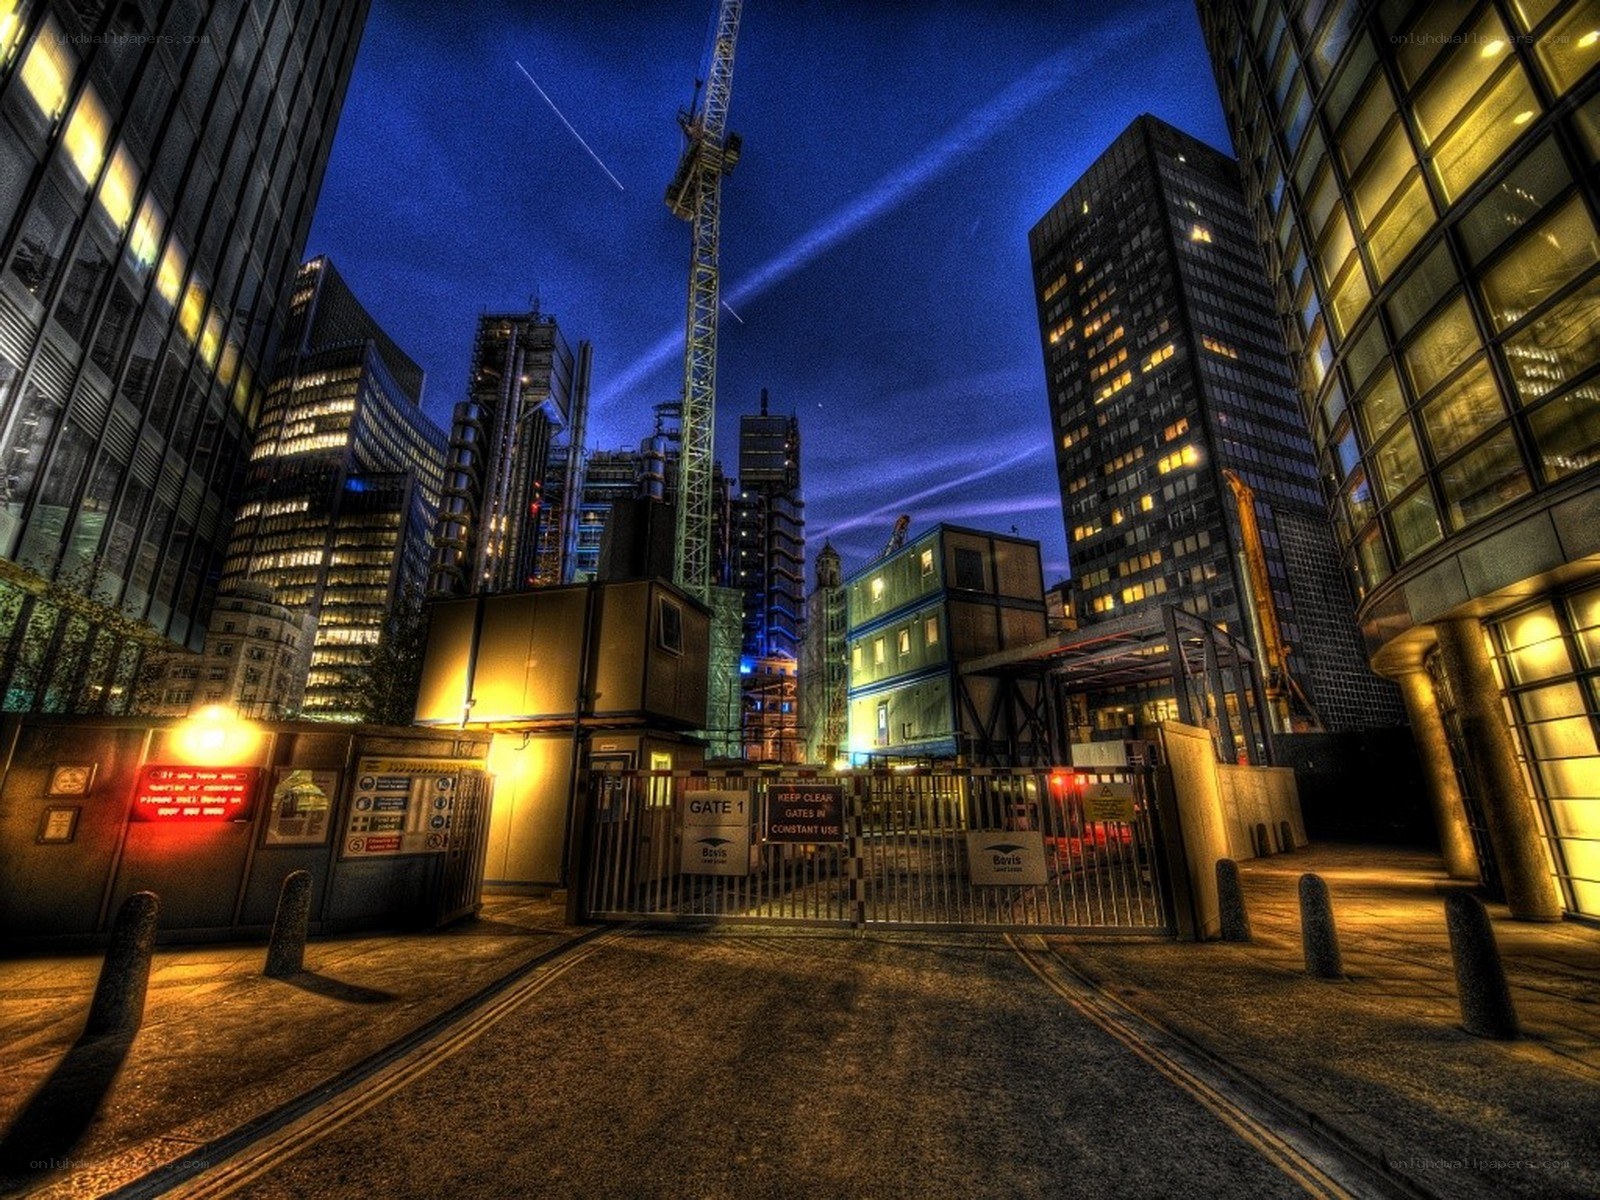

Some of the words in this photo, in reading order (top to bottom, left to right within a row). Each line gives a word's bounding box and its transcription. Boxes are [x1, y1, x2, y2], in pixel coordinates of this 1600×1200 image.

[777, 793, 800, 803] KEEP
[802, 793, 833, 803] CLEAR
[690, 800, 732, 815] GATE
[737, 800, 745, 814] 1
[785, 809, 814, 819] GATES
[816, 810, 826, 819] IN
[771, 825, 819, 835] CONSTANT
[820, 826, 839, 836] USE
[993, 854, 1021, 865] Bovis
